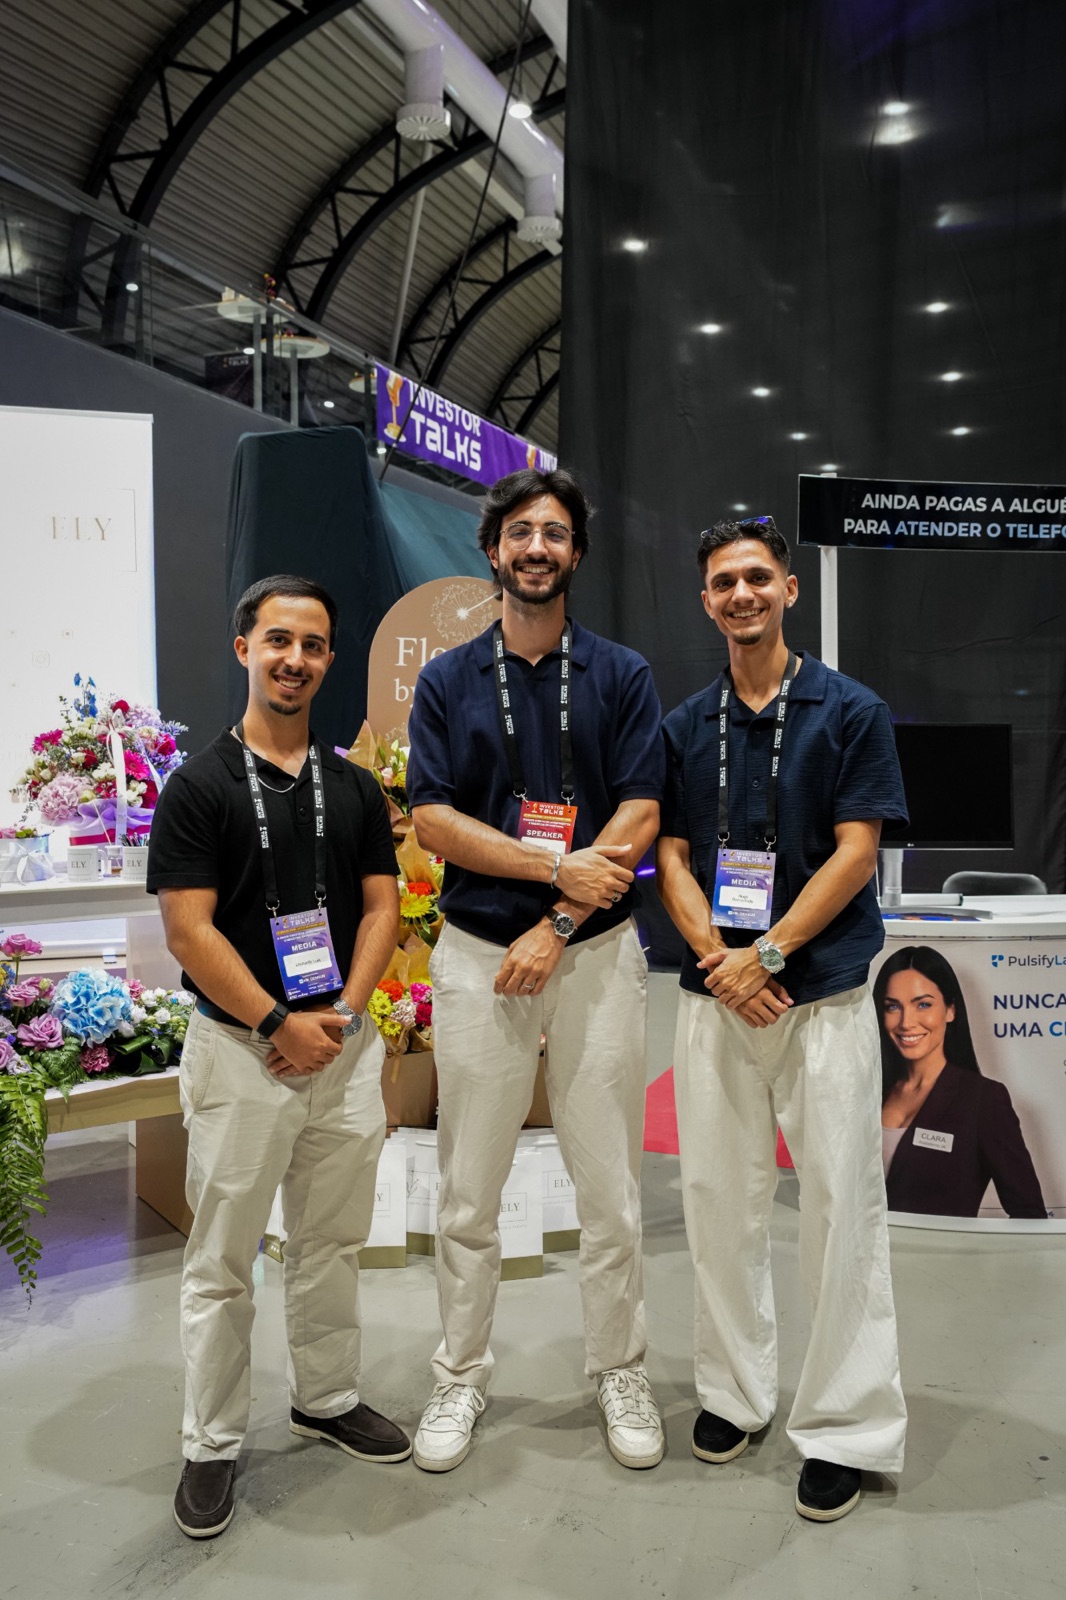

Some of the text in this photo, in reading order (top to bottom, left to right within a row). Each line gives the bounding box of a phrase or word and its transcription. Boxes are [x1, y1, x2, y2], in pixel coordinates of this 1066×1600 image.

[409, 380, 481, 437] INVESTOR
[861, 493, 920, 510] AINDA
[925, 495, 987, 512] PAGAS
[991, 497, 1005, 513] A
[51, 516, 111, 541] ELY
[844, 518, 891, 535] PARA
[895, 520, 982, 537] ATENDER
[986, 522, 1001, 538] O
[526, 829, 563, 839] SPEAKER
[291, 941, 317, 952] MEDIA
[994, 993, 1066, 1010] NUNCA
[994, 1022, 1043, 1038] UMA
[921, 1133, 946, 1143] CLARA
